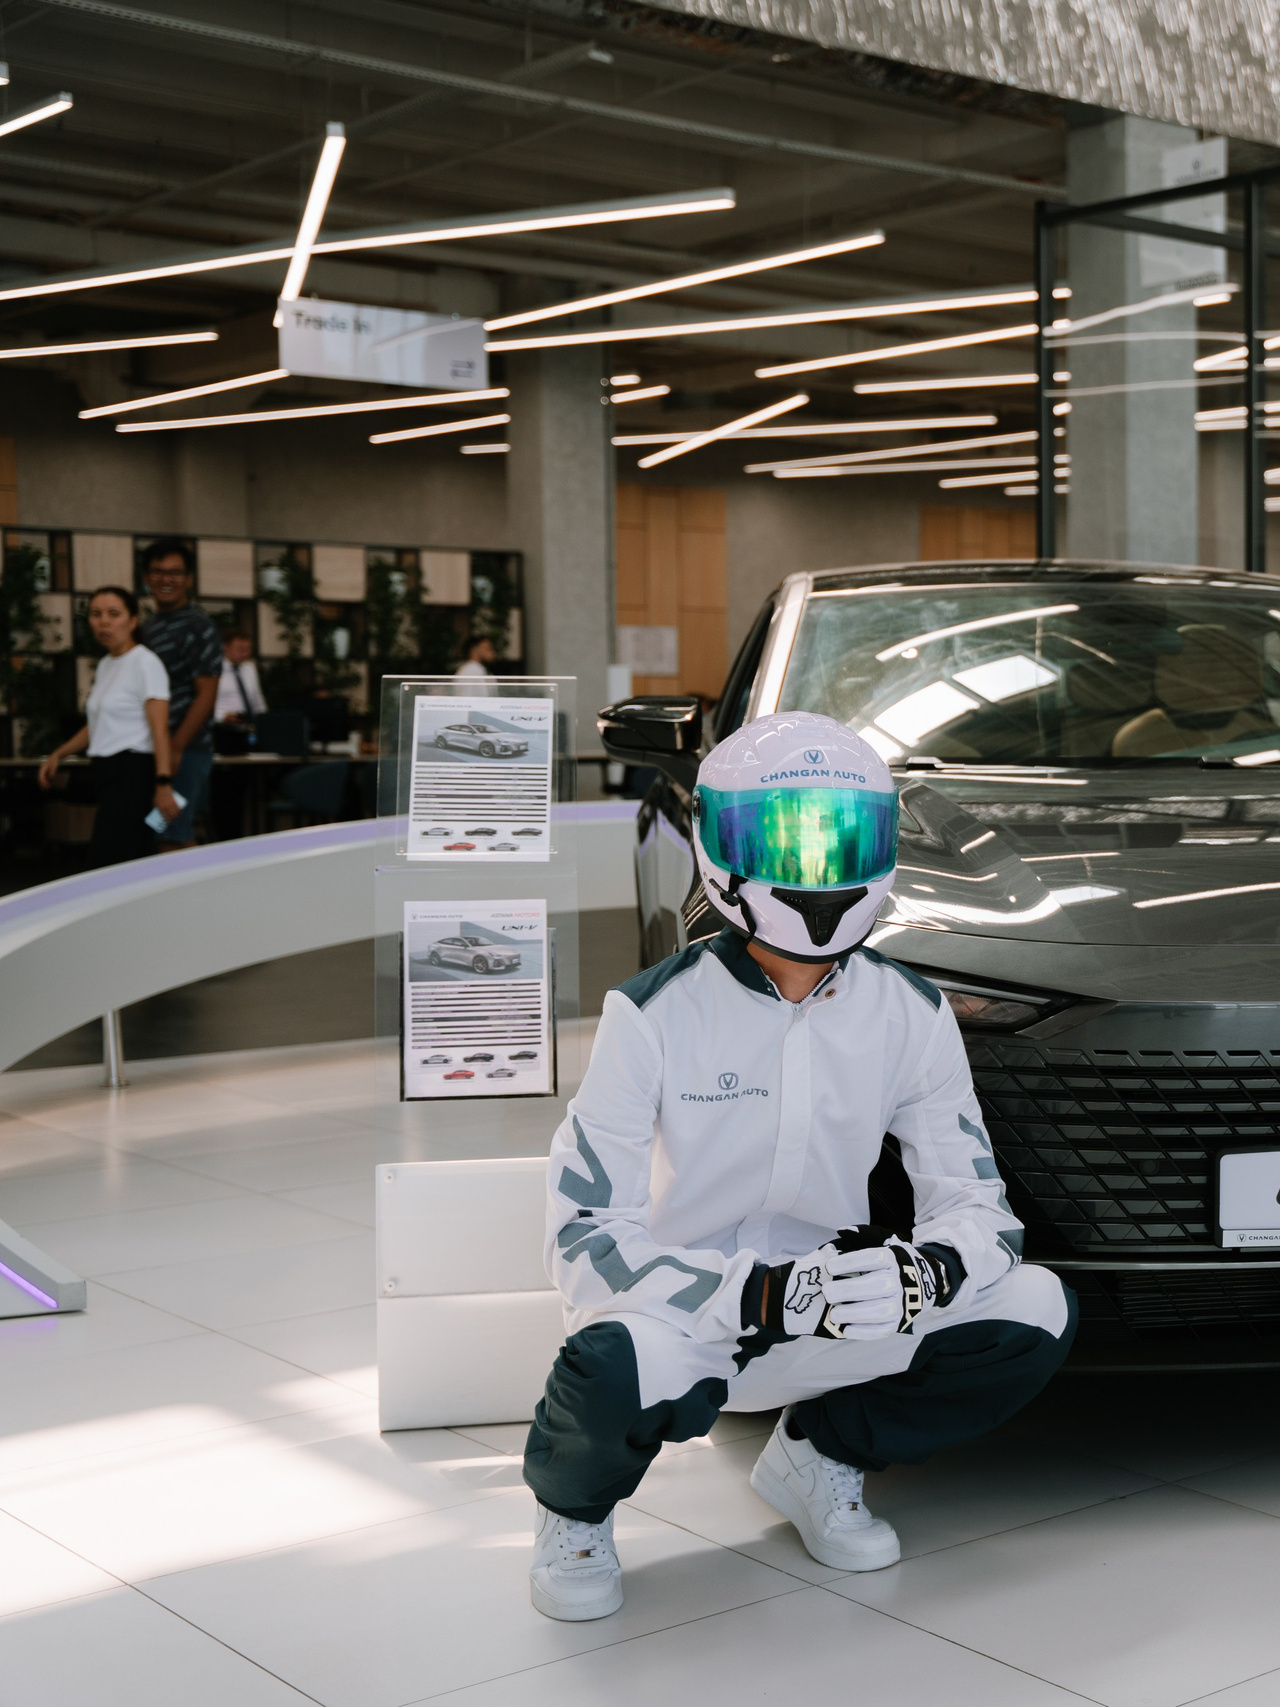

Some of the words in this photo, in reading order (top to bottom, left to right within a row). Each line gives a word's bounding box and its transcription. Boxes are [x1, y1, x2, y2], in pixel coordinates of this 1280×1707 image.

[289, 309, 348, 332] Trade
[760, 769, 830, 783] CHANGAN
[833, 770, 866, 783] AUTO
[680, 1092, 739, 1102] CHANGAN
[740, 1087, 769, 1097] AUTO
